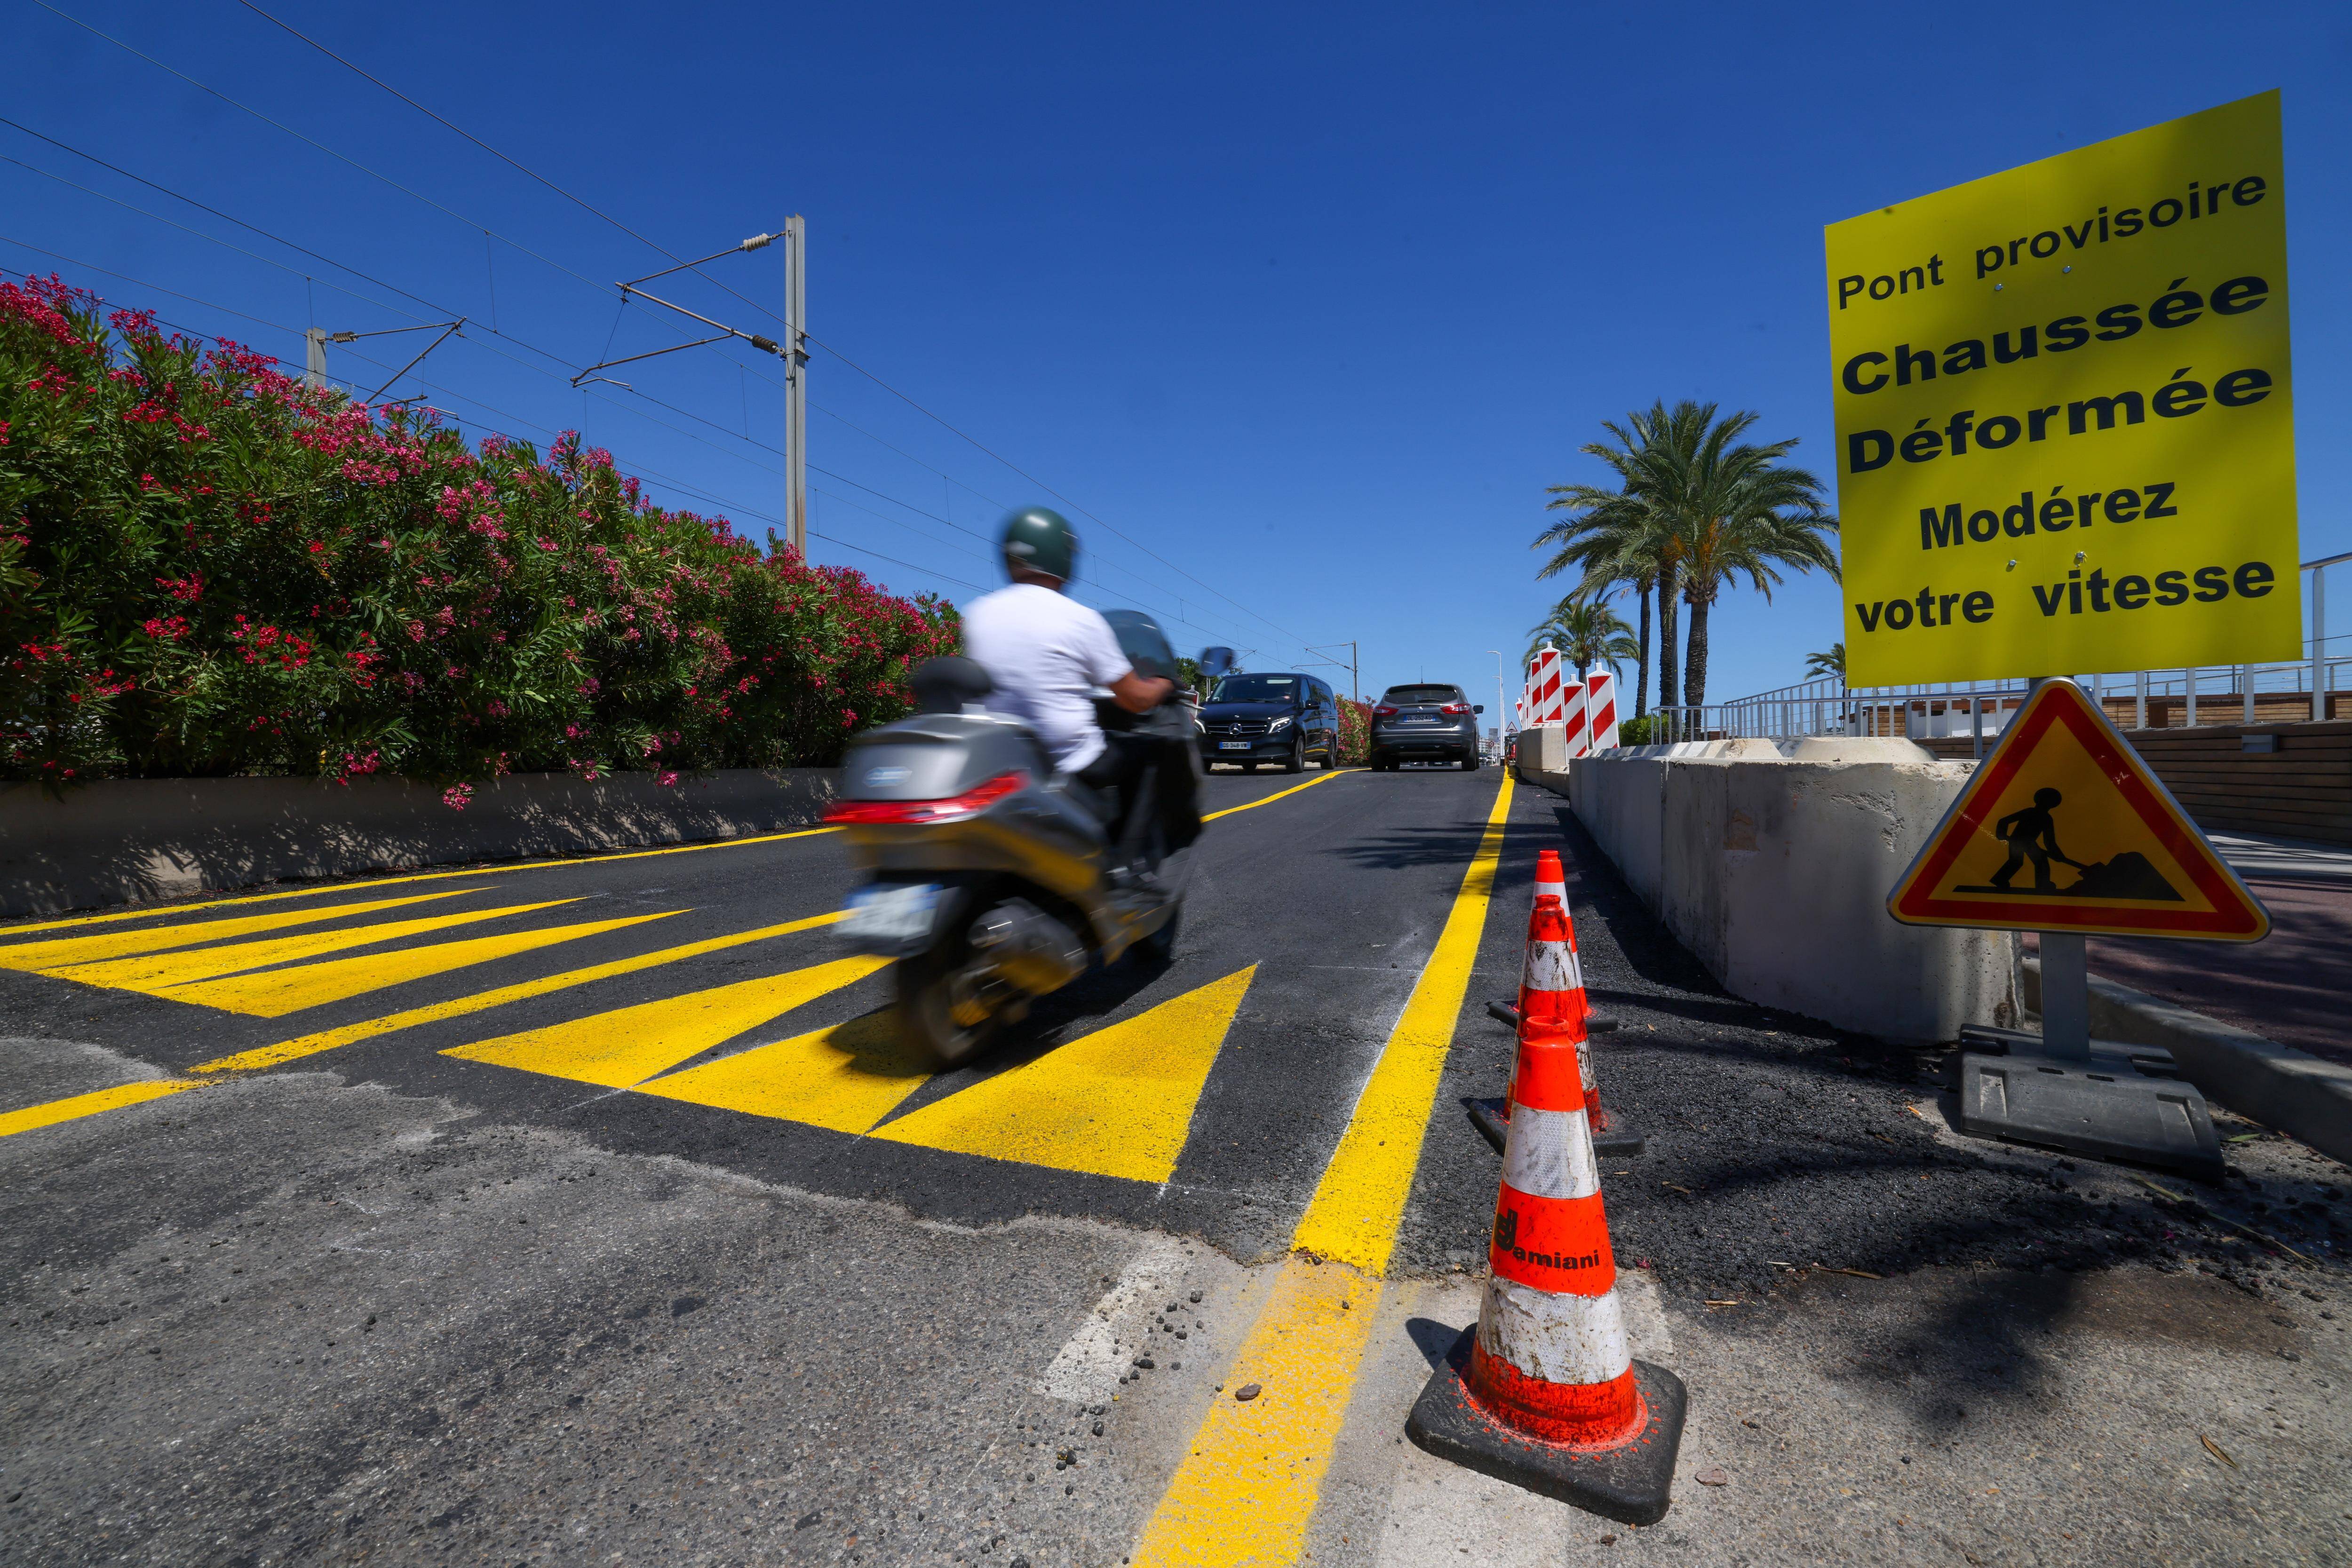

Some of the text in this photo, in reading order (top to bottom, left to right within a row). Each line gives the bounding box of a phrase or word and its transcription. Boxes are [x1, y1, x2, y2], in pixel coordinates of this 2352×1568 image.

[1838, 175, 2267, 309] Pont provisoire
[1843, 276, 2269, 395] Chaussée
[1848, 367, 2273, 474] Déformée
[1920, 482, 2177, 550] Modérez
[1855, 562, 2275, 633] votre vitesse
